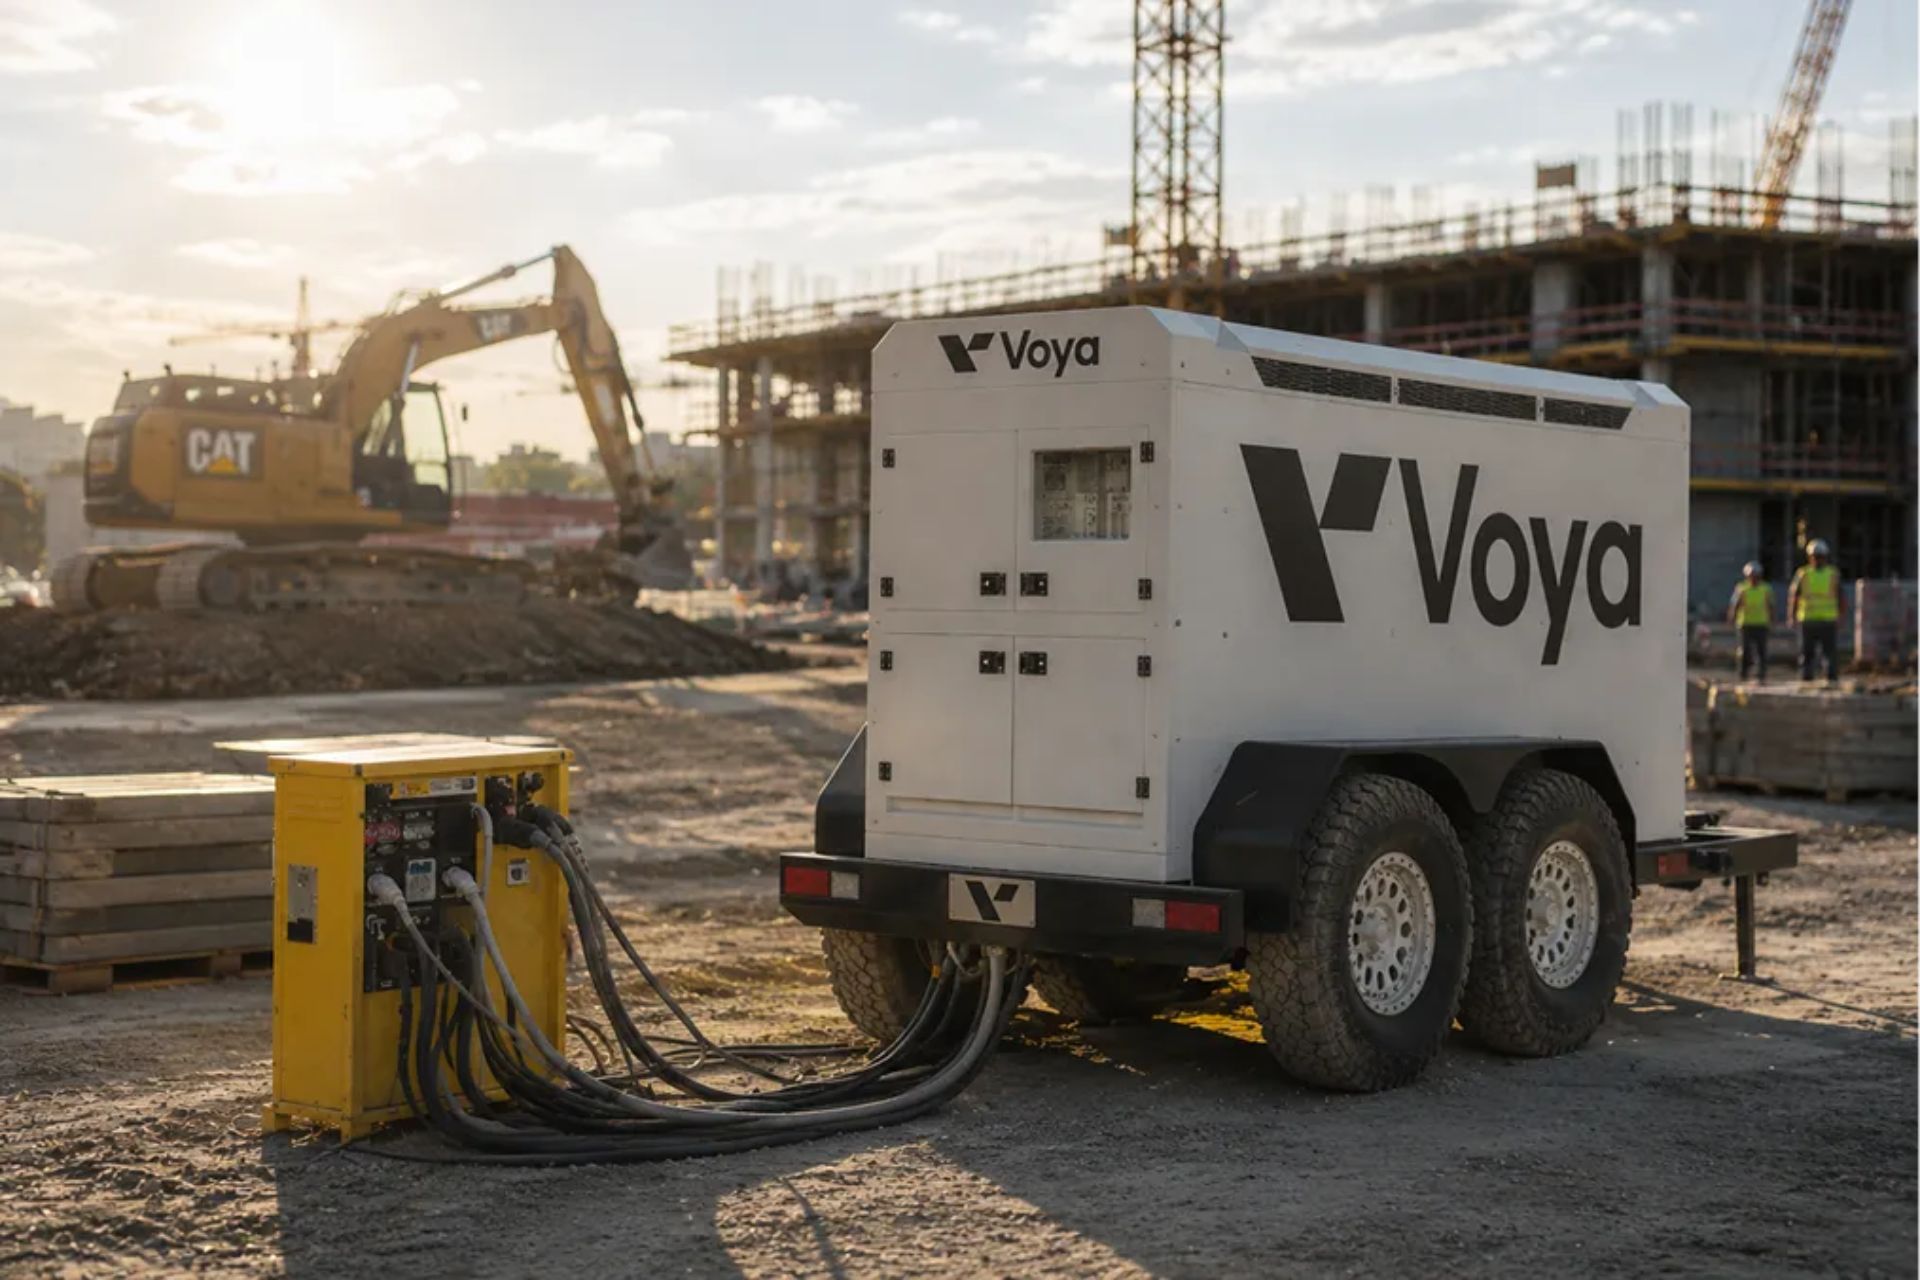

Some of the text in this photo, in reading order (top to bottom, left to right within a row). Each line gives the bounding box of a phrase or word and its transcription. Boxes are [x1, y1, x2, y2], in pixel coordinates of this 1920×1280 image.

[1000, 329, 1100, 378] Voya
[188, 429, 254, 474] CAT
[1398, 458, 1643, 666] Voya
